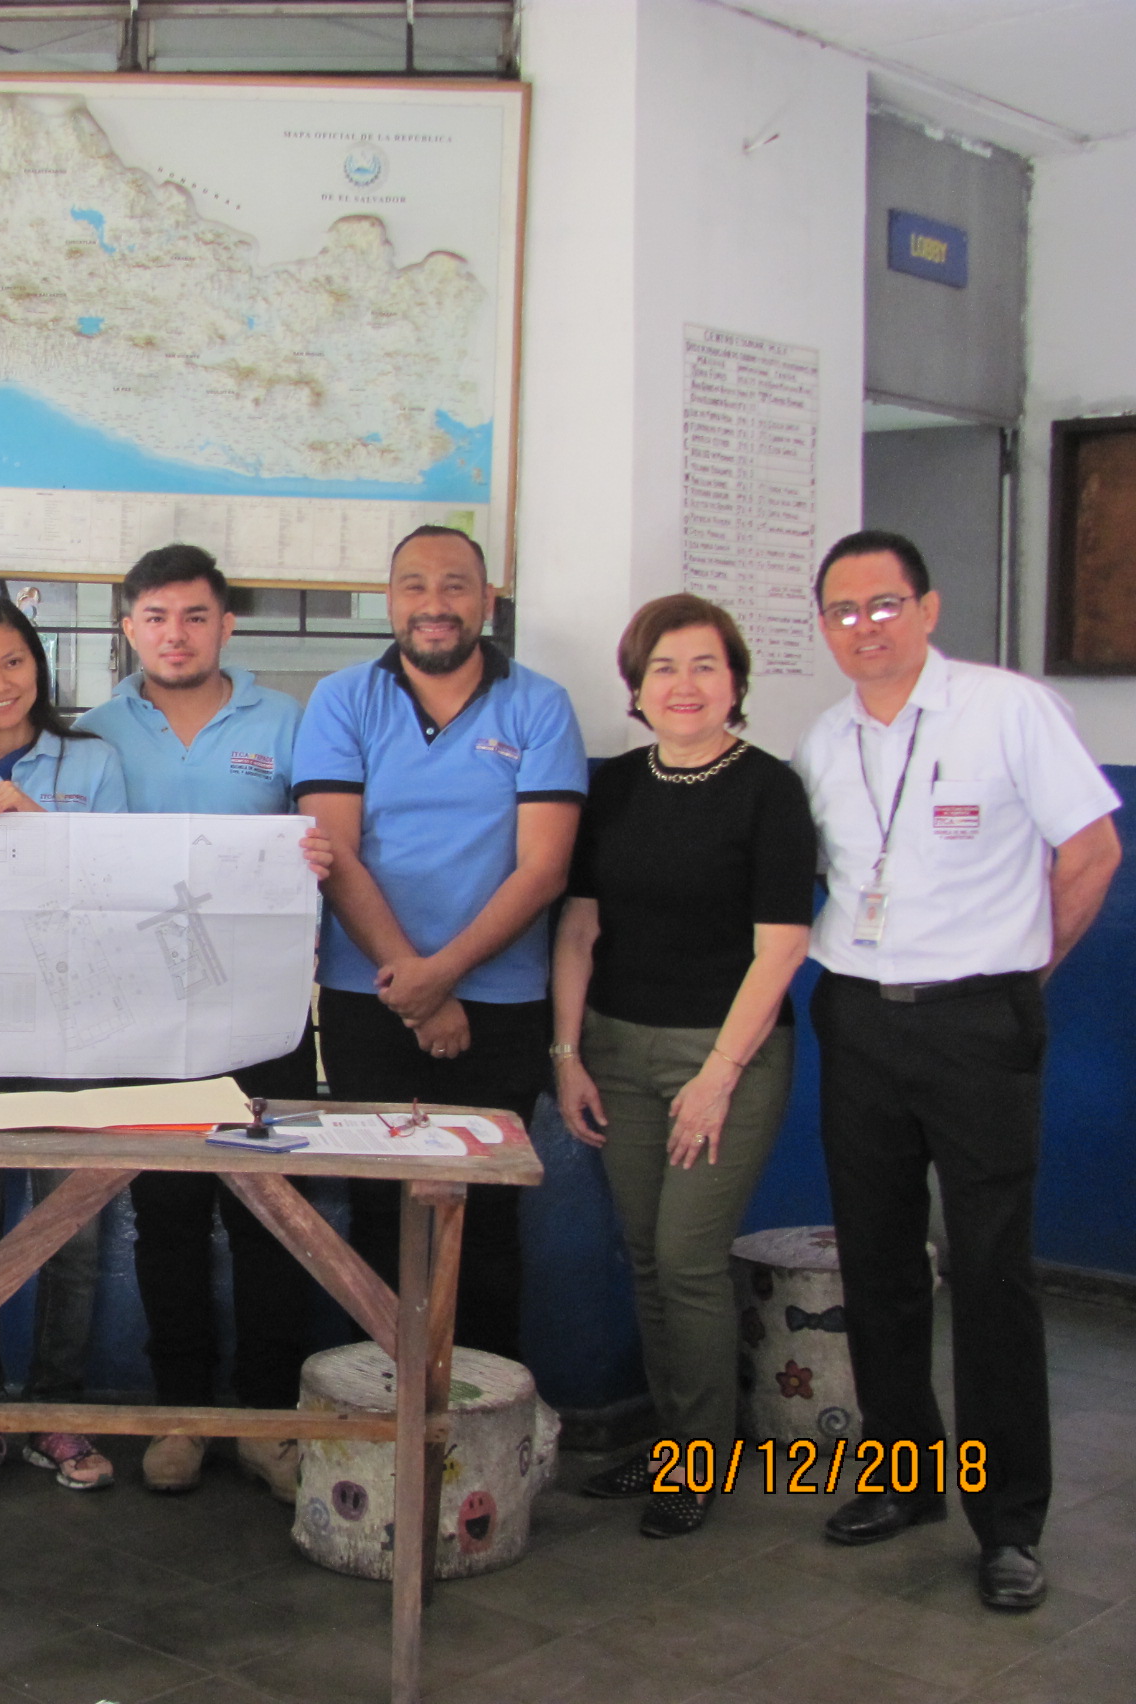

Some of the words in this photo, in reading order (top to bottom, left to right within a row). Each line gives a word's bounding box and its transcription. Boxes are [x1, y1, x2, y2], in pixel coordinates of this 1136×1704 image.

[283, 131, 311, 139] MAPA
[314, 132, 355, 141] OFICIAL
[354, 195, 406, 203] SALVADOR
